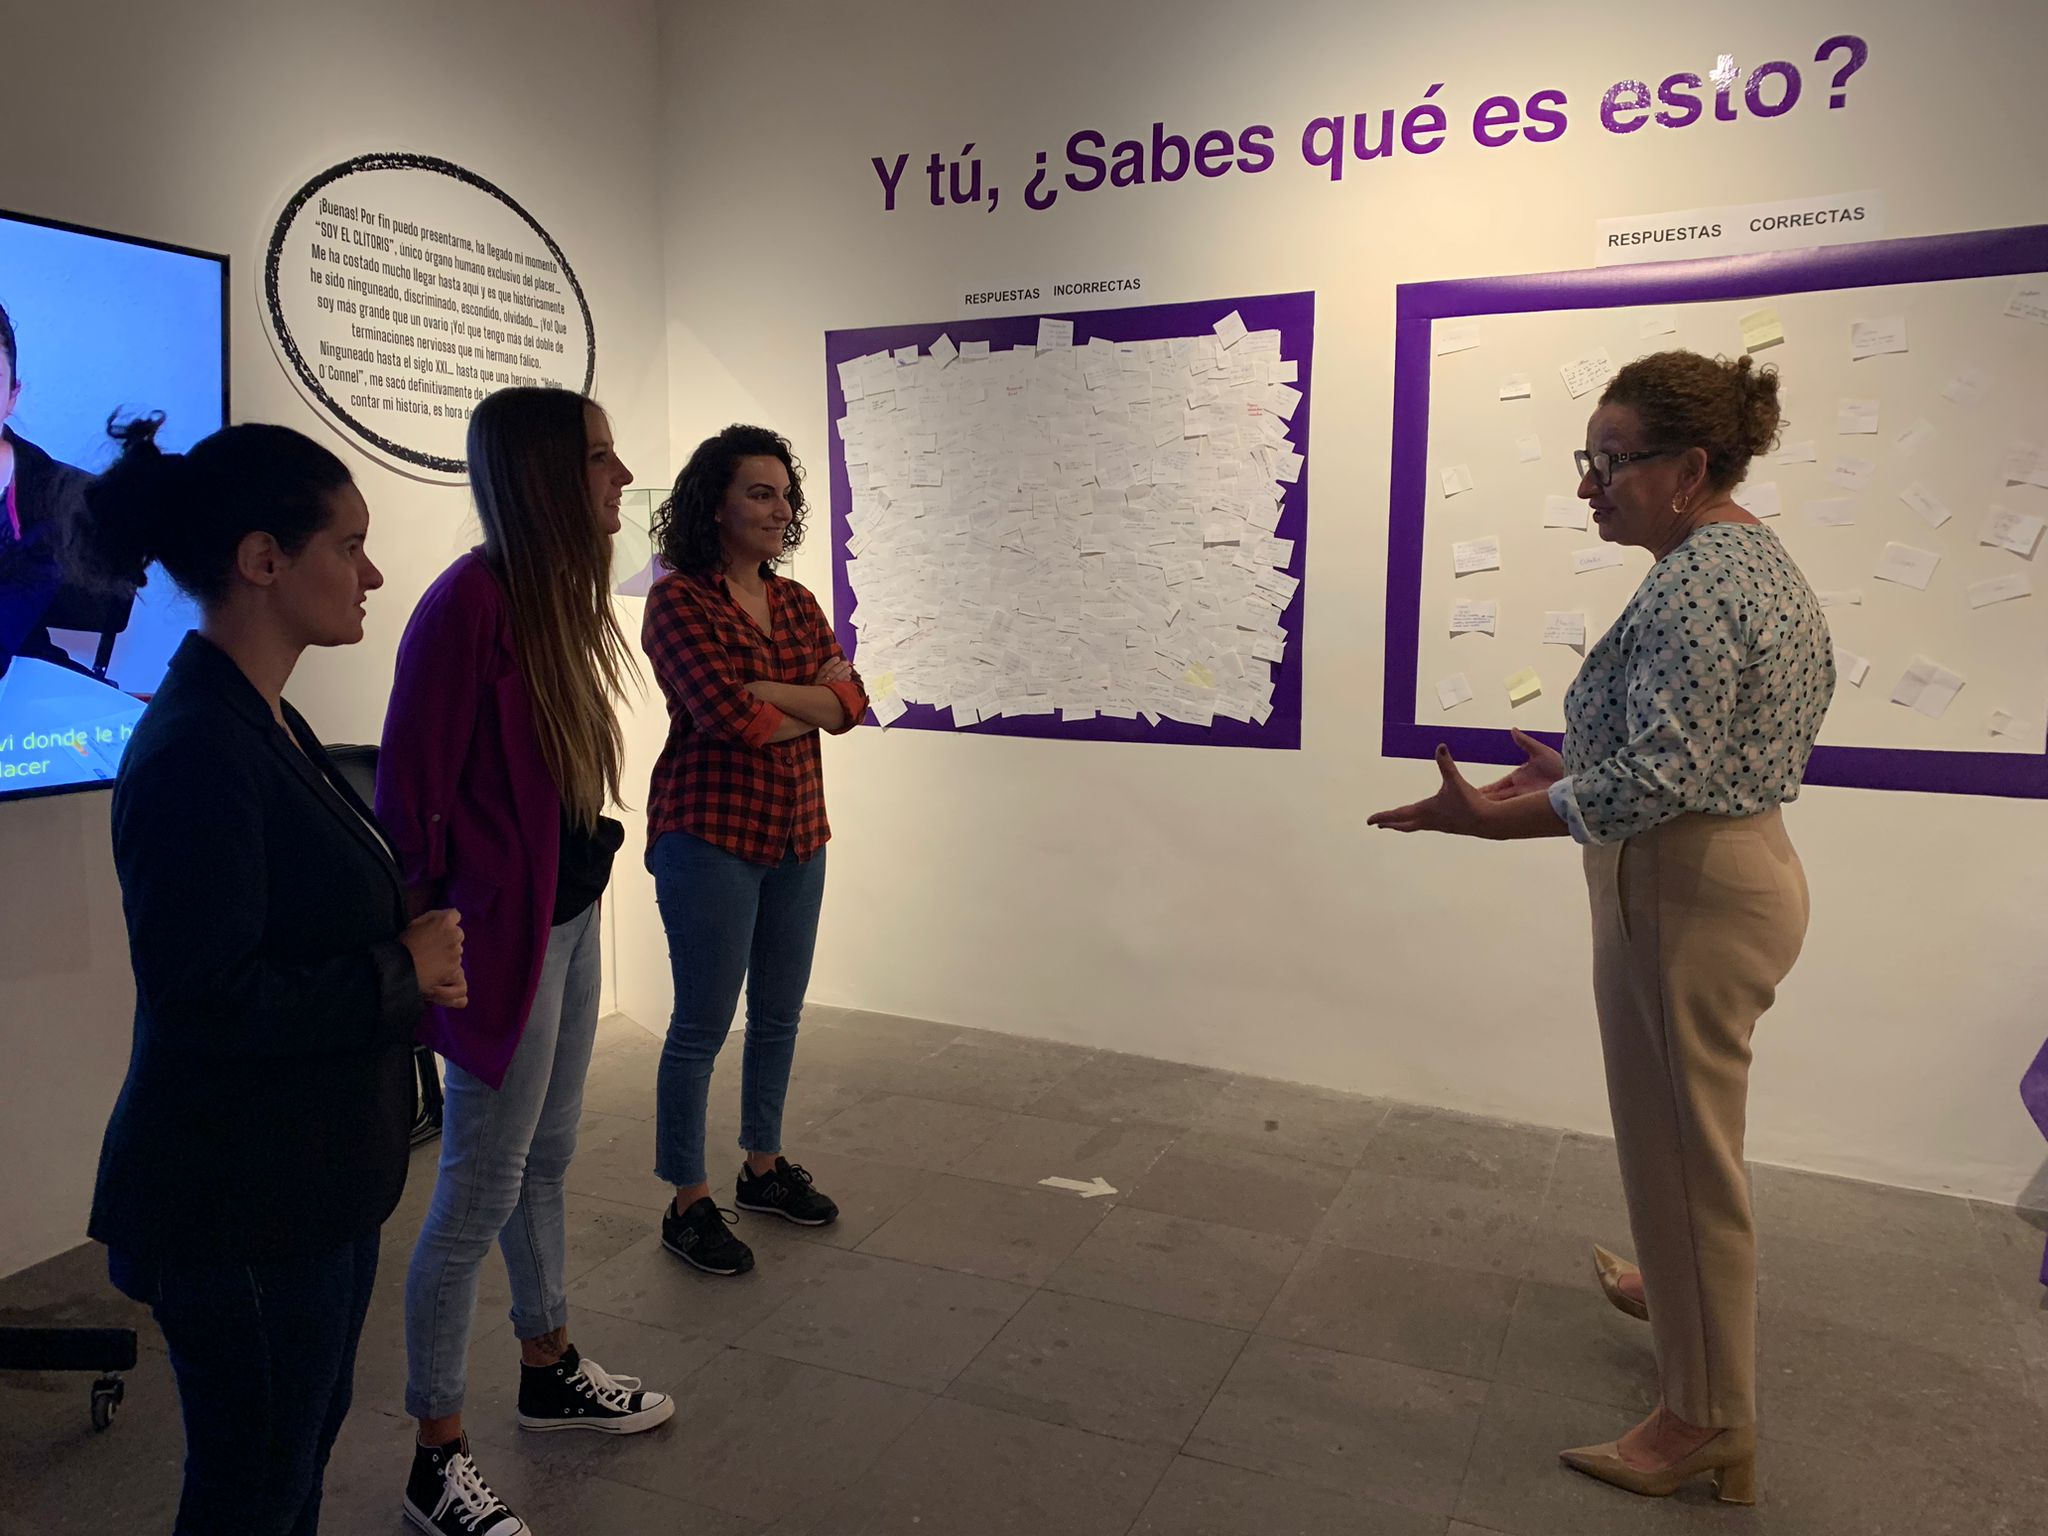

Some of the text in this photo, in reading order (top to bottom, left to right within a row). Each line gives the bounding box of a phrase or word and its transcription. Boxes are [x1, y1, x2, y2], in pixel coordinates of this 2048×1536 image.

[870, 35, 1869, 213] Y tú, ¿Sabes qué es esto?
[319, 198, 558, 273] ¡Buenas! Por fin puedo presentarme, ha llegado mi momento
[1608, 207, 1866, 247] RESPUESTAS CORRECTAS
[311, 243, 326, 260] Me
[329, 248, 340, 264] ha
[343, 254, 379, 273] costado
[382, 263, 411, 280] mucho
[413, 267, 436, 286] llegar
[438, 273, 461, 291] hasta
[481, 286, 485, 299] y
[488, 287, 496, 299] es
[498, 290, 512, 303] que
[341, 227, 351, 243] EL
[400, 243, 423, 260] único
[425, 248, 453, 267] órgano
[454, 256, 485, 275] humano
[487, 266, 521, 285] exclusivo
[522, 273, 533, 287] del
[310, 267, 322, 284] he
[325, 271, 345, 289] sido
[347, 276, 402, 301] ninguneado,
[404, 289, 459, 313] discriminado,
[461, 302, 502, 323] escondido,
[540, 317, 553, 332] ¡Yo!
[554, 320, 567, 335] Que
[965, 278, 1141, 305] RESPUESTAS INCORRECTAS
[317, 296, 564, 354] soy más grande que un ovario ¡Yo! que tengo más del doble de
[352, 323, 414, 347] terminaciones
[417, 337, 456, 354] nerviosas
[458, 344, 472, 358] que
[474, 346, 484, 359] mi
[485, 346, 518, 365] hermano
[320, 340, 374, 363] Ninguneado
[376, 350, 401, 367] hasta
[403, 355, 411, 369] el
[413, 356, 433, 374] siglo
[456, 363, 478, 379] hasta
[480, 369, 494, 382] que
[495, 370, 509, 384] una
[351, 394, 379, 409] contar
[382, 397, 394, 411] mi
[396, 397, 431, 416] historia,
[433, 405, 443, 417] es
[445, 404, 462, 419] hora
[369, 374, 383, 387] me
[386, 376, 406, 390] sacó
[408, 376, 472, 400] definitivamente
[473, 387, 483, 400] de
[23, 728, 88, 750] donde
[95, 726, 113, 743] le
